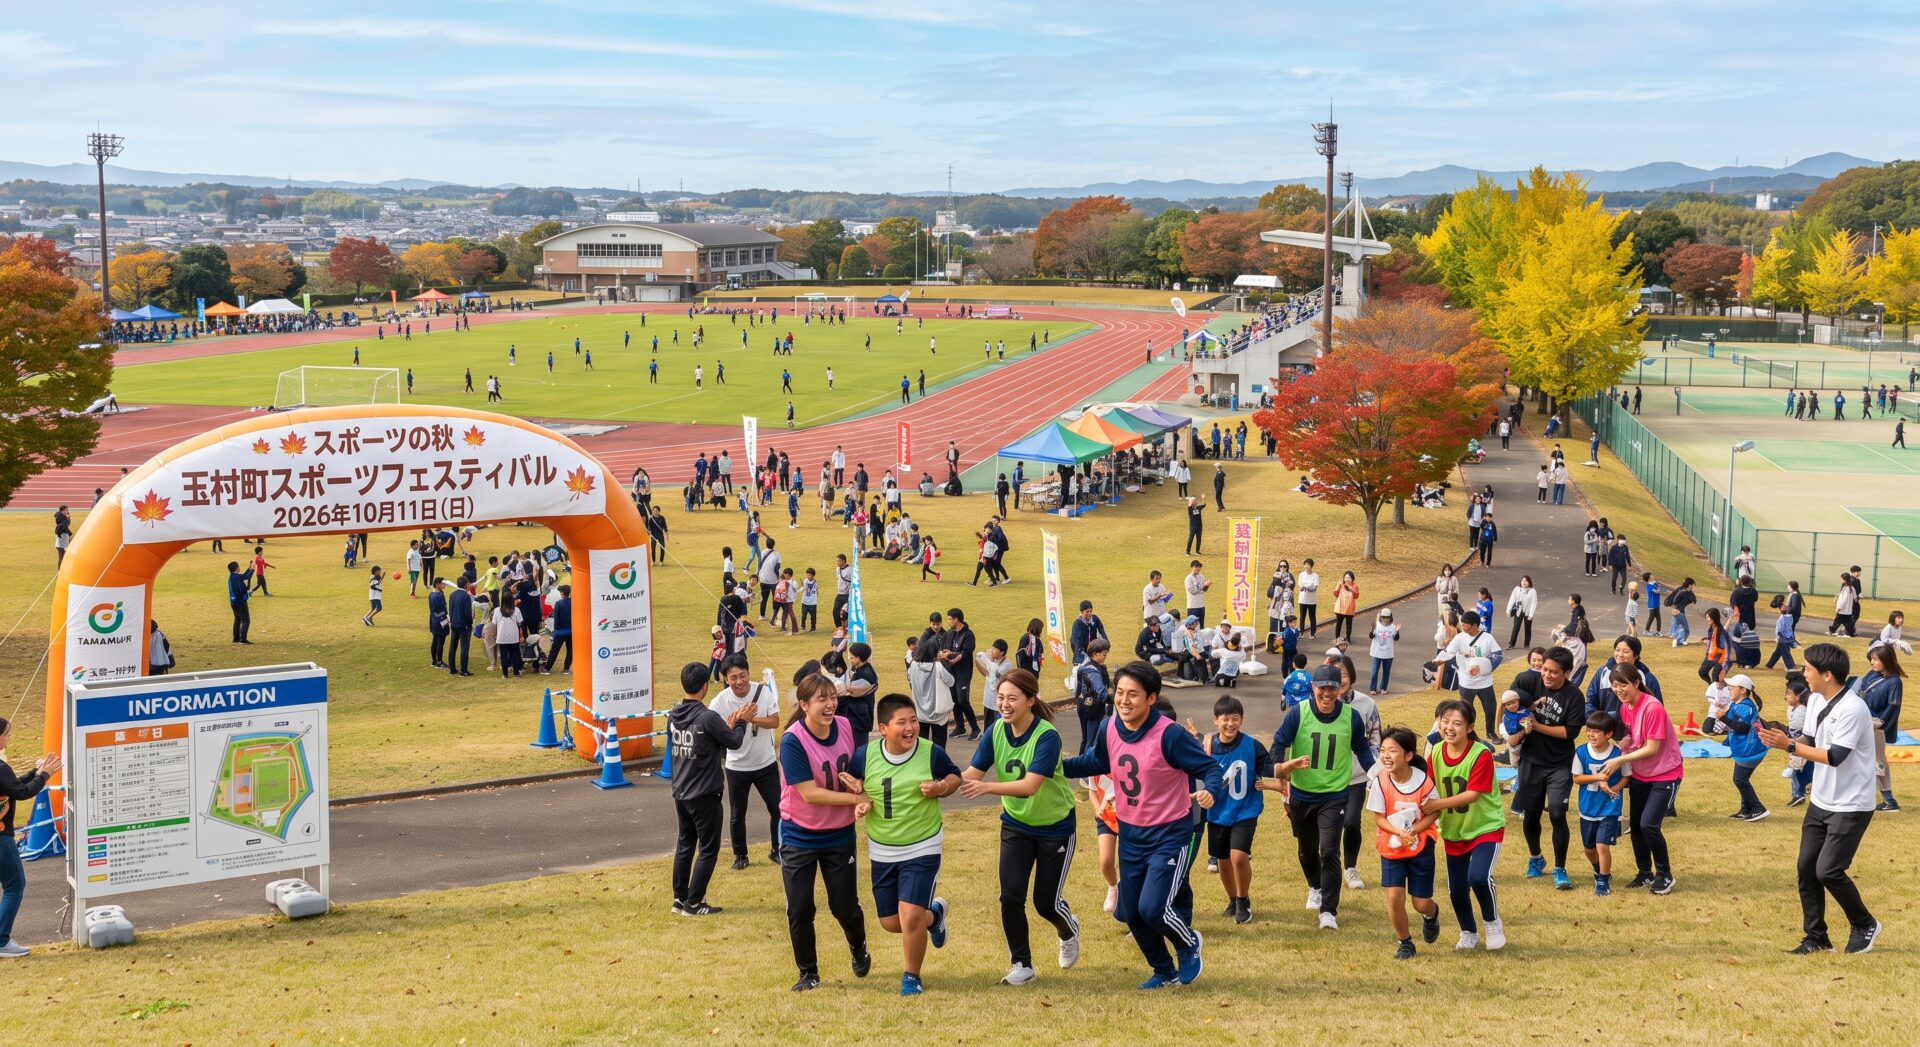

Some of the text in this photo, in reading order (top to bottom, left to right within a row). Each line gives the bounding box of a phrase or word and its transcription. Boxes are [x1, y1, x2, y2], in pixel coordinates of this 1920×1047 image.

[314, 424, 455, 456] スポーツの秋
[181, 454, 557, 507] 玉村町スポーツフェスティバル
[272, 496, 475, 528] 2026年10月11日(日)
[128, 686, 276, 717] INFORMATION
[1311, 732, 1336, 770] 11
[1118, 754, 1141, 798] 3
[881, 777, 893, 819] 1
